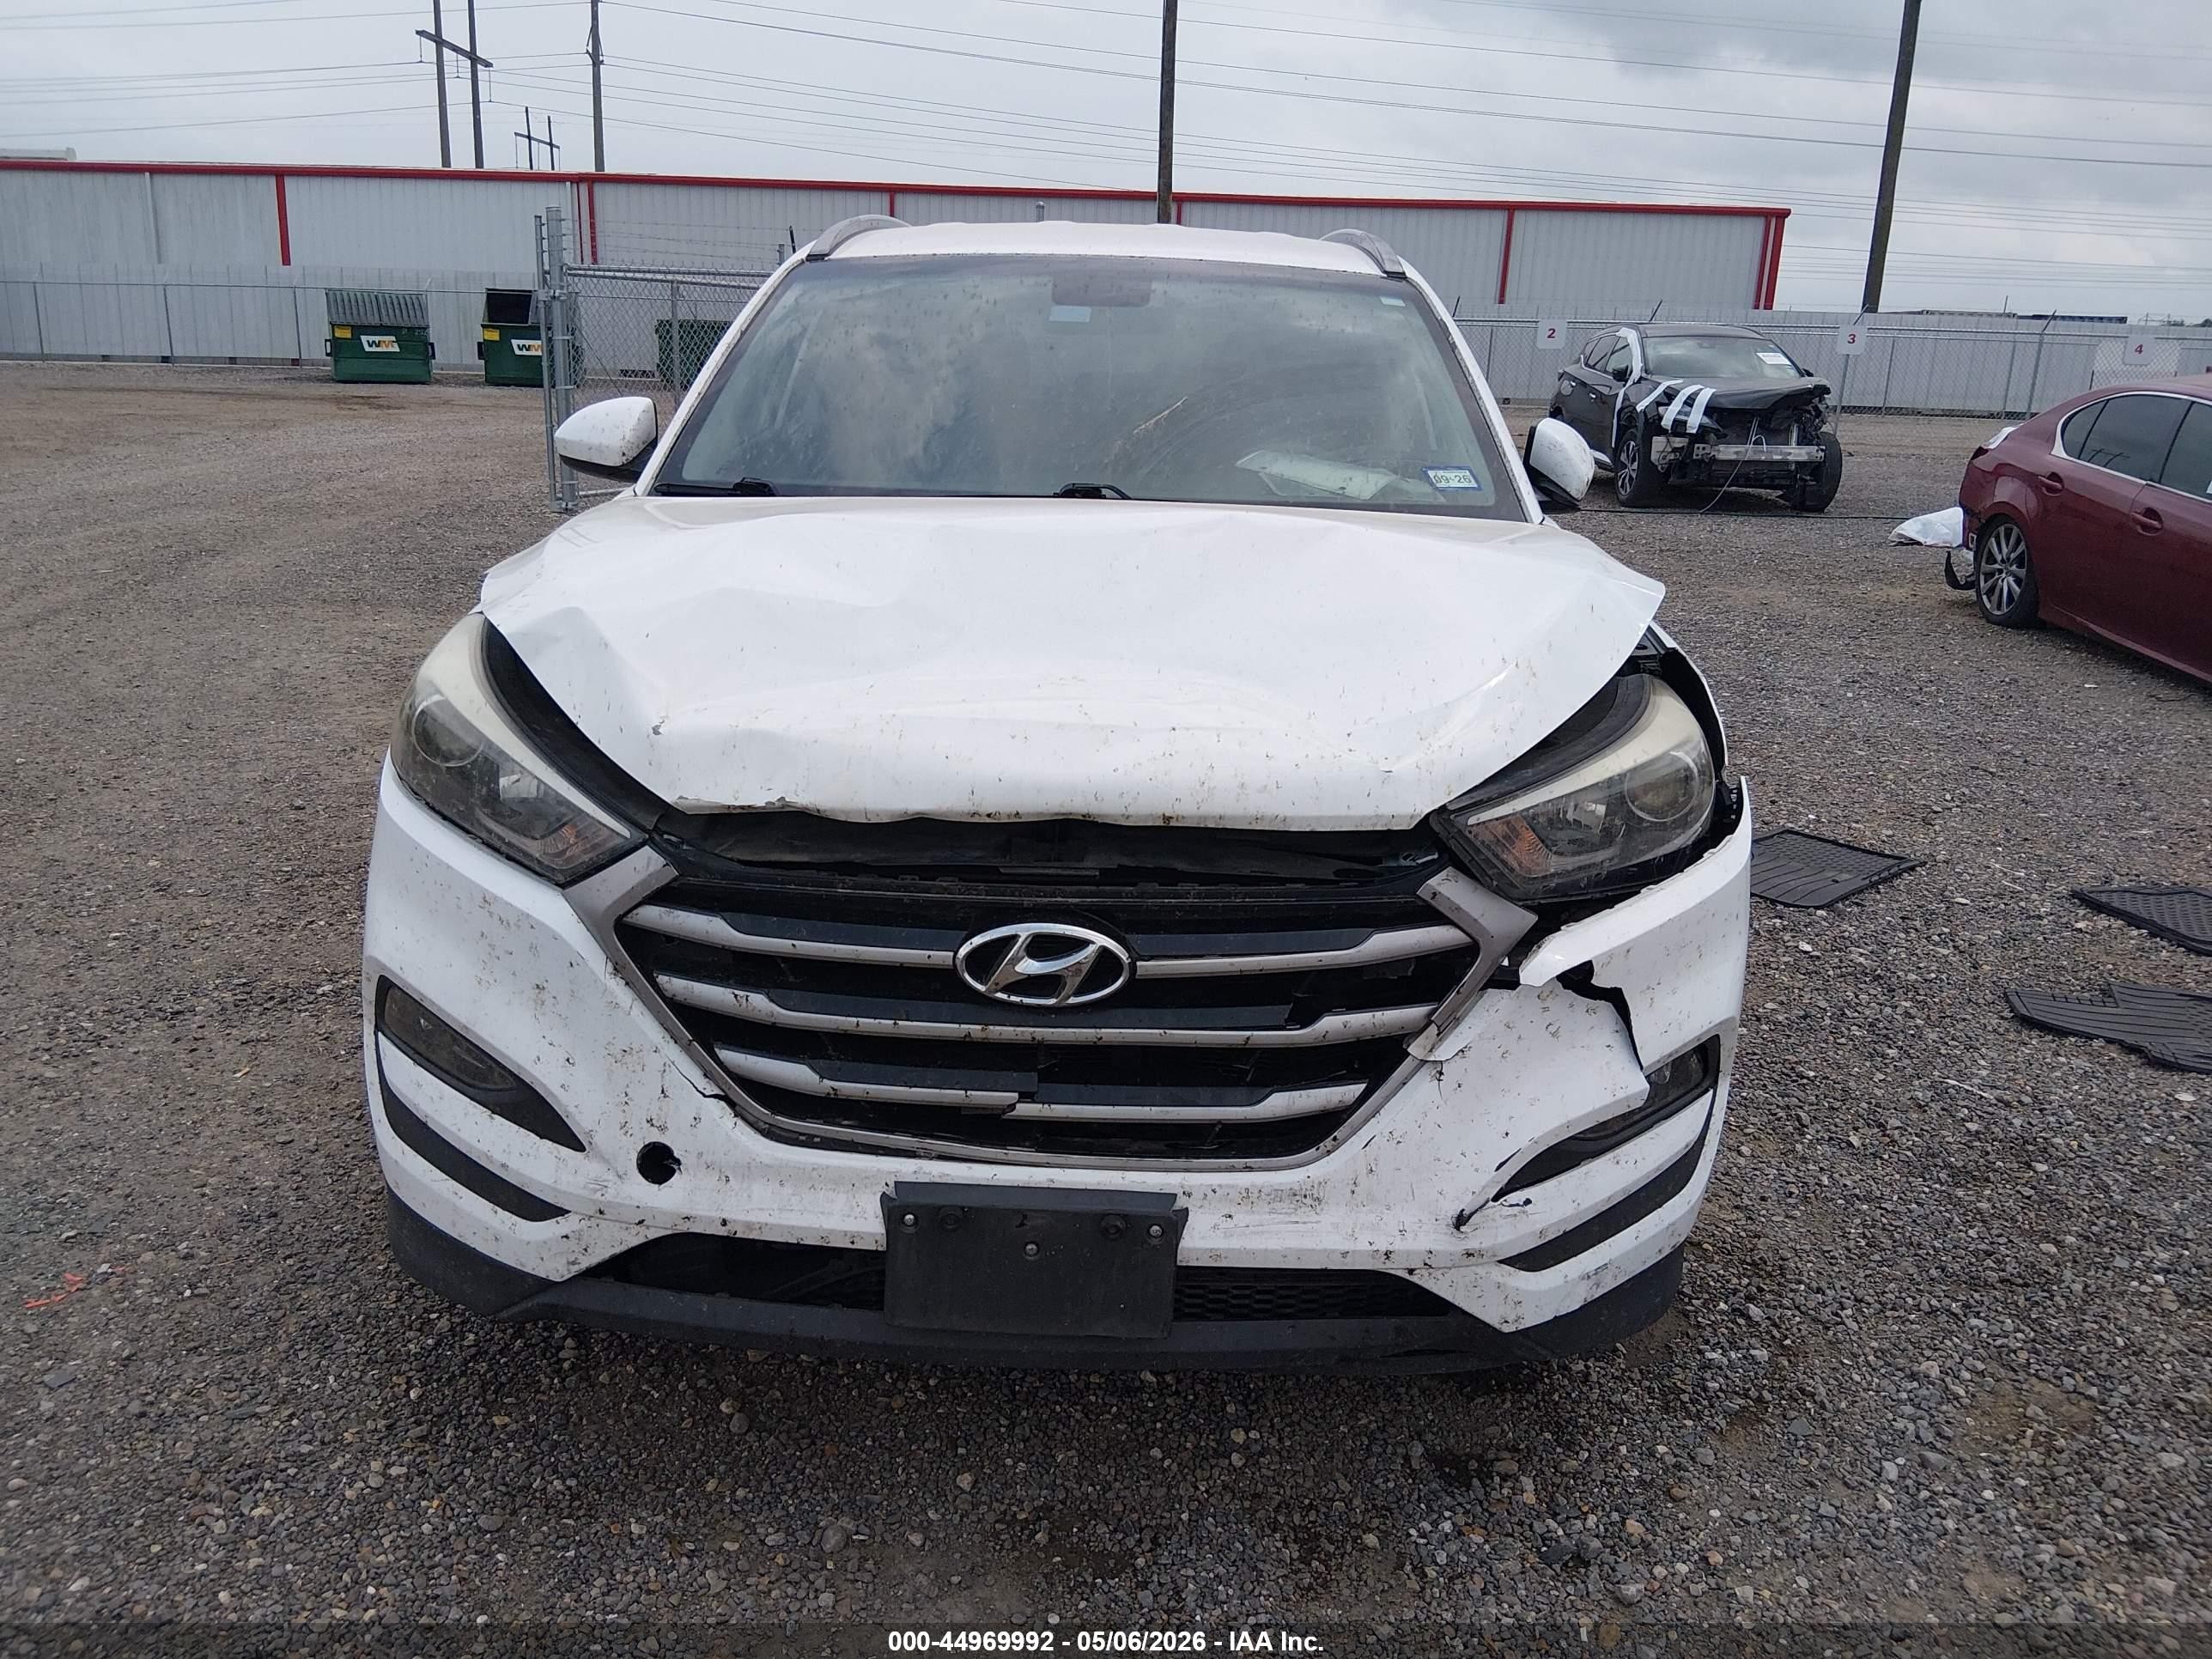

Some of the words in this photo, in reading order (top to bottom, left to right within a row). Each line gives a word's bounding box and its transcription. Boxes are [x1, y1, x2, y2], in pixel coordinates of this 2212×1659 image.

[1547, 328, 1556, 338] 2
[366, 339, 396, 348] WM
[1847, 333, 1856, 344] 3
[2134, 343, 2144, 355] 4
